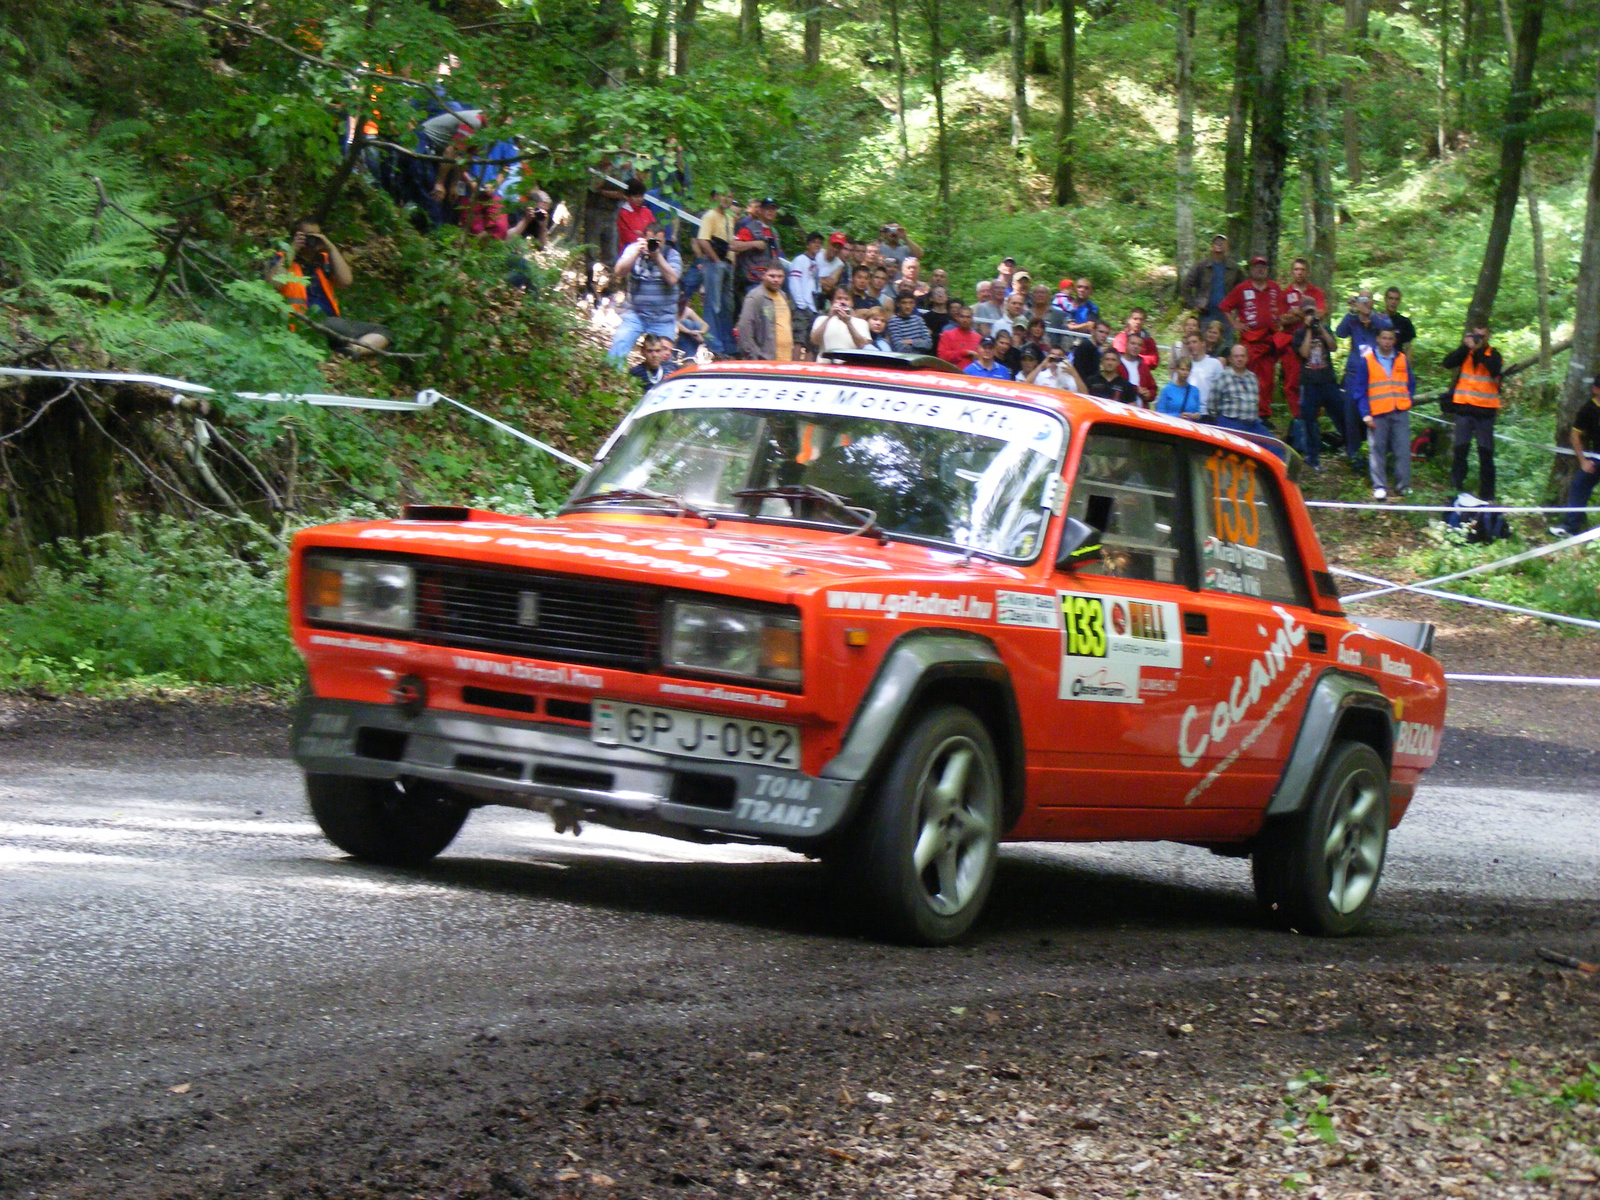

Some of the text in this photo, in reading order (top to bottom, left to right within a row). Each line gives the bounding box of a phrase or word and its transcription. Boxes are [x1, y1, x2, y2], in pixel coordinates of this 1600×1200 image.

[680, 384, 821, 403] Budapest
[833, 389, 941, 417] Motors
[1205, 449, 1259, 547] 133
[1061, 595, 1107, 657] 133
[452, 655, 604, 689] www.bizol.hu
[625, 708, 792, 764] GPJ-092
[1395, 720, 1435, 757] BIZOL
[755, 774, 812, 800] TOM
[736, 798, 822, 828] TRANS
